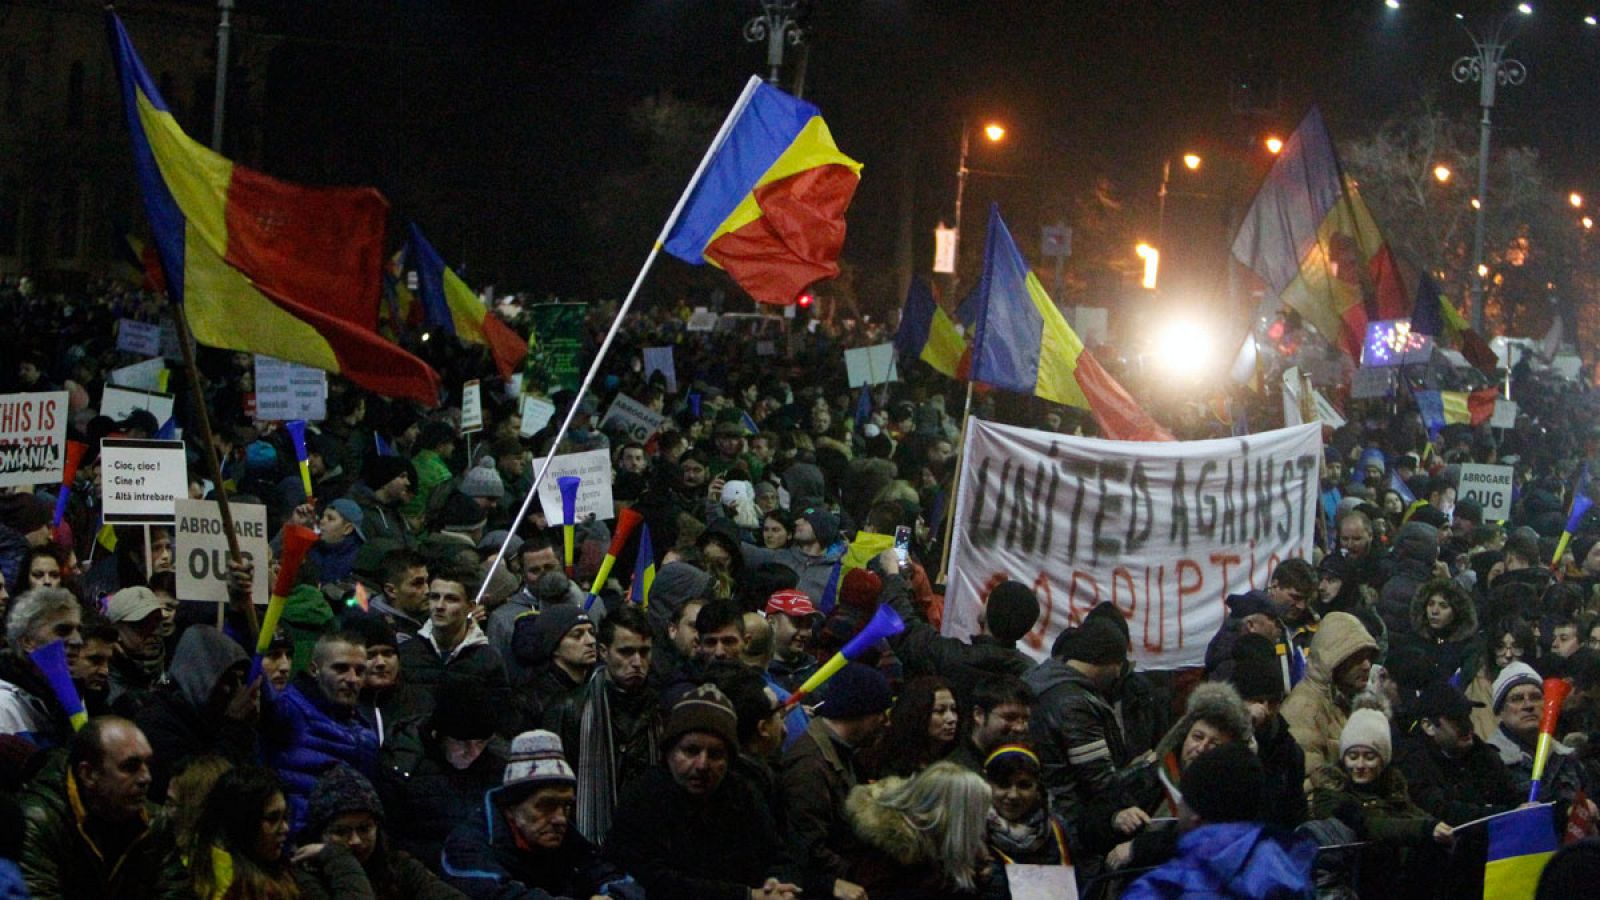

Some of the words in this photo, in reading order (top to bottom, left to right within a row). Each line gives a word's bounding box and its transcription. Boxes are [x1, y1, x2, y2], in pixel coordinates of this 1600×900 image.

[0, 401, 33, 433] HIS
[38, 399, 56, 431] IS
[114, 460, 136, 472] Cioc,
[114, 475, 133, 486] Cine
[135, 476, 146, 486] e?
[1463, 472, 1511, 485] ABROGARE
[179, 517, 264, 538] ABROARE
